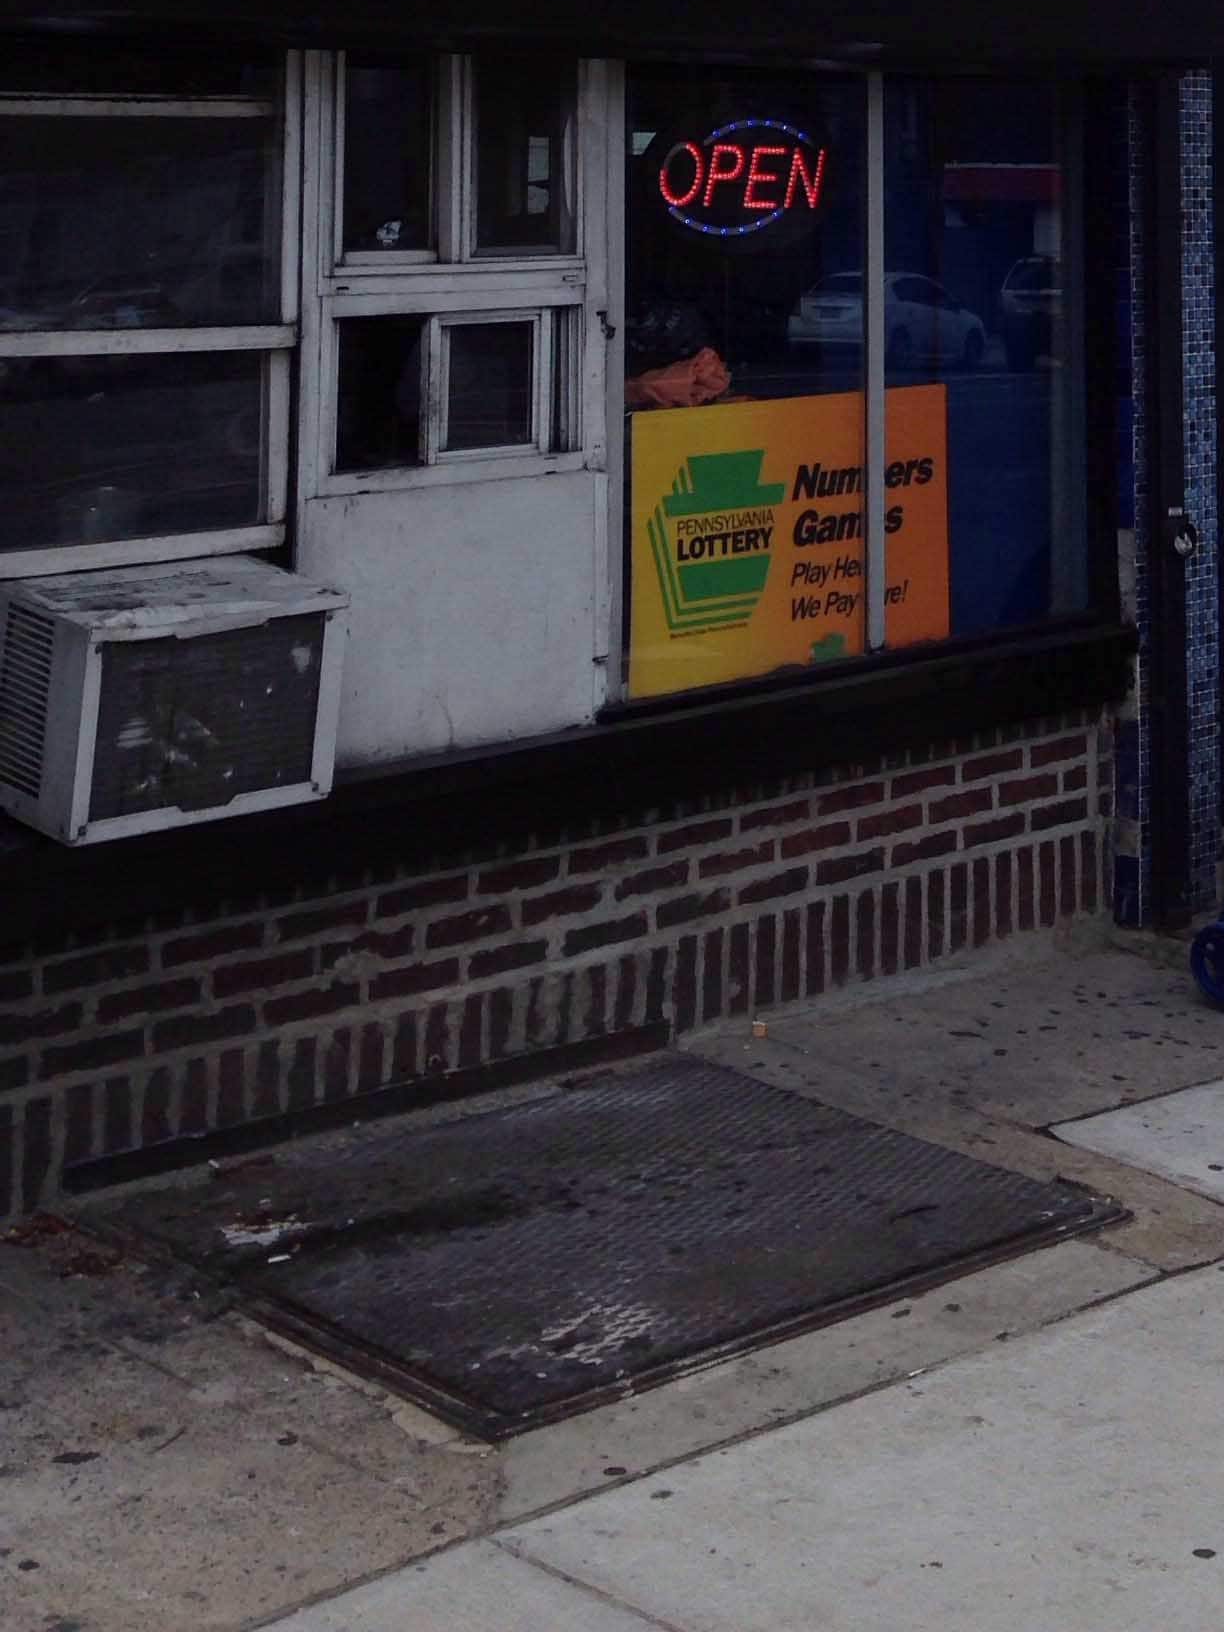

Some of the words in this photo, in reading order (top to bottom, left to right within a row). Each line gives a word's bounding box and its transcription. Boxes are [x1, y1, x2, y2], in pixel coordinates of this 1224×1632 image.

[659, 142, 826, 209] OPEN
[792, 457, 934, 501] Numers
[676, 509, 775, 536] PENNSYLVANIA
[792, 506, 904, 547] Gams
[676, 527, 774, 561] LOTTERY
[791, 561, 836, 588] Play
[833, 555, 865, 579] He
[791, 597, 821, 621] We
[824, 590, 860, 618] Pay
